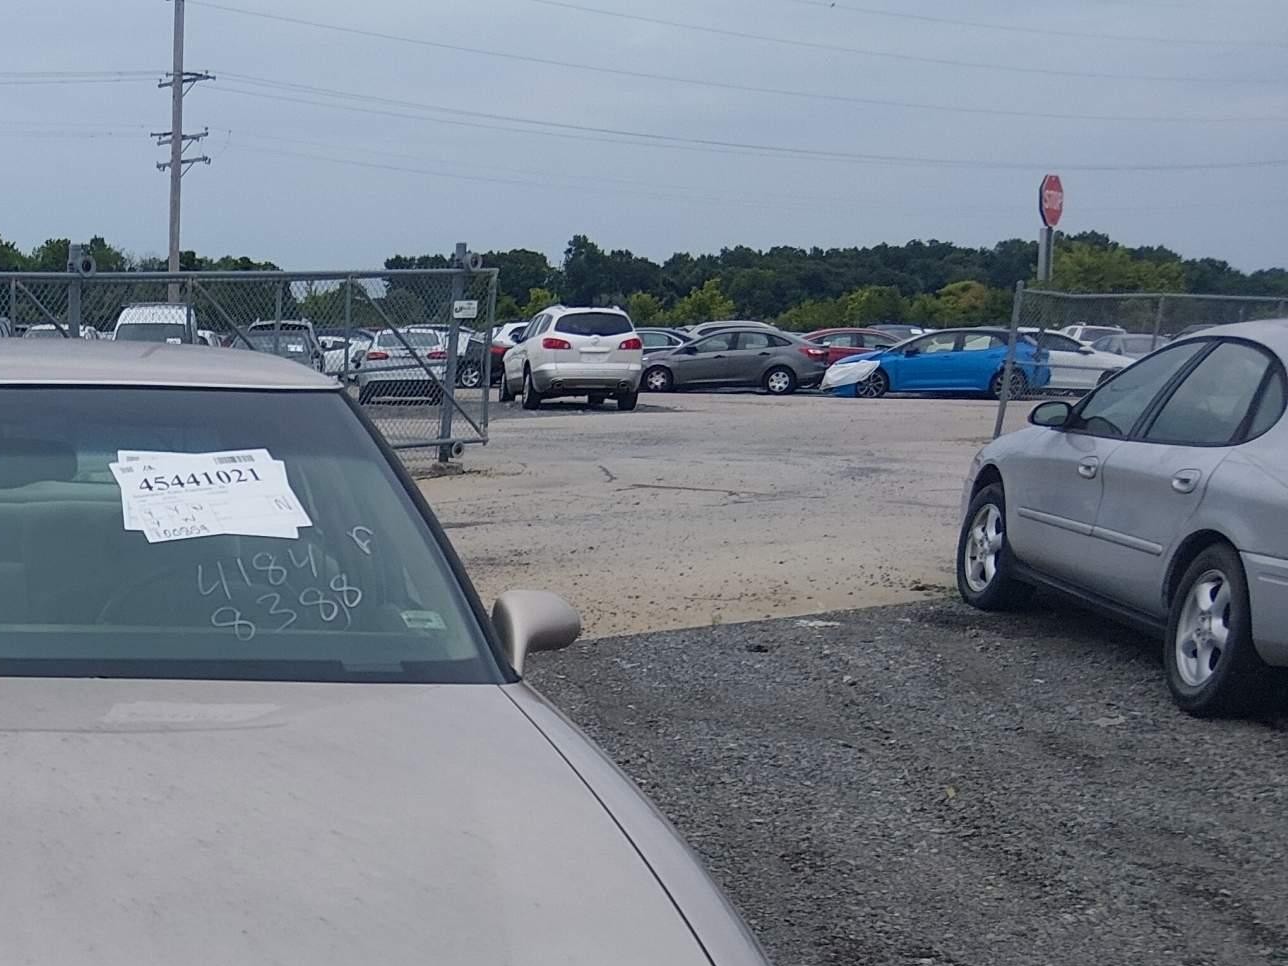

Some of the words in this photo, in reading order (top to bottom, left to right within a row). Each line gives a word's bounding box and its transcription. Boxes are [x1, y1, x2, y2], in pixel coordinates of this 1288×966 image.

[139, 466, 263, 492] 45441021
[197, 543, 319, 600] 4184
[211, 573, 362, 641] 8388
